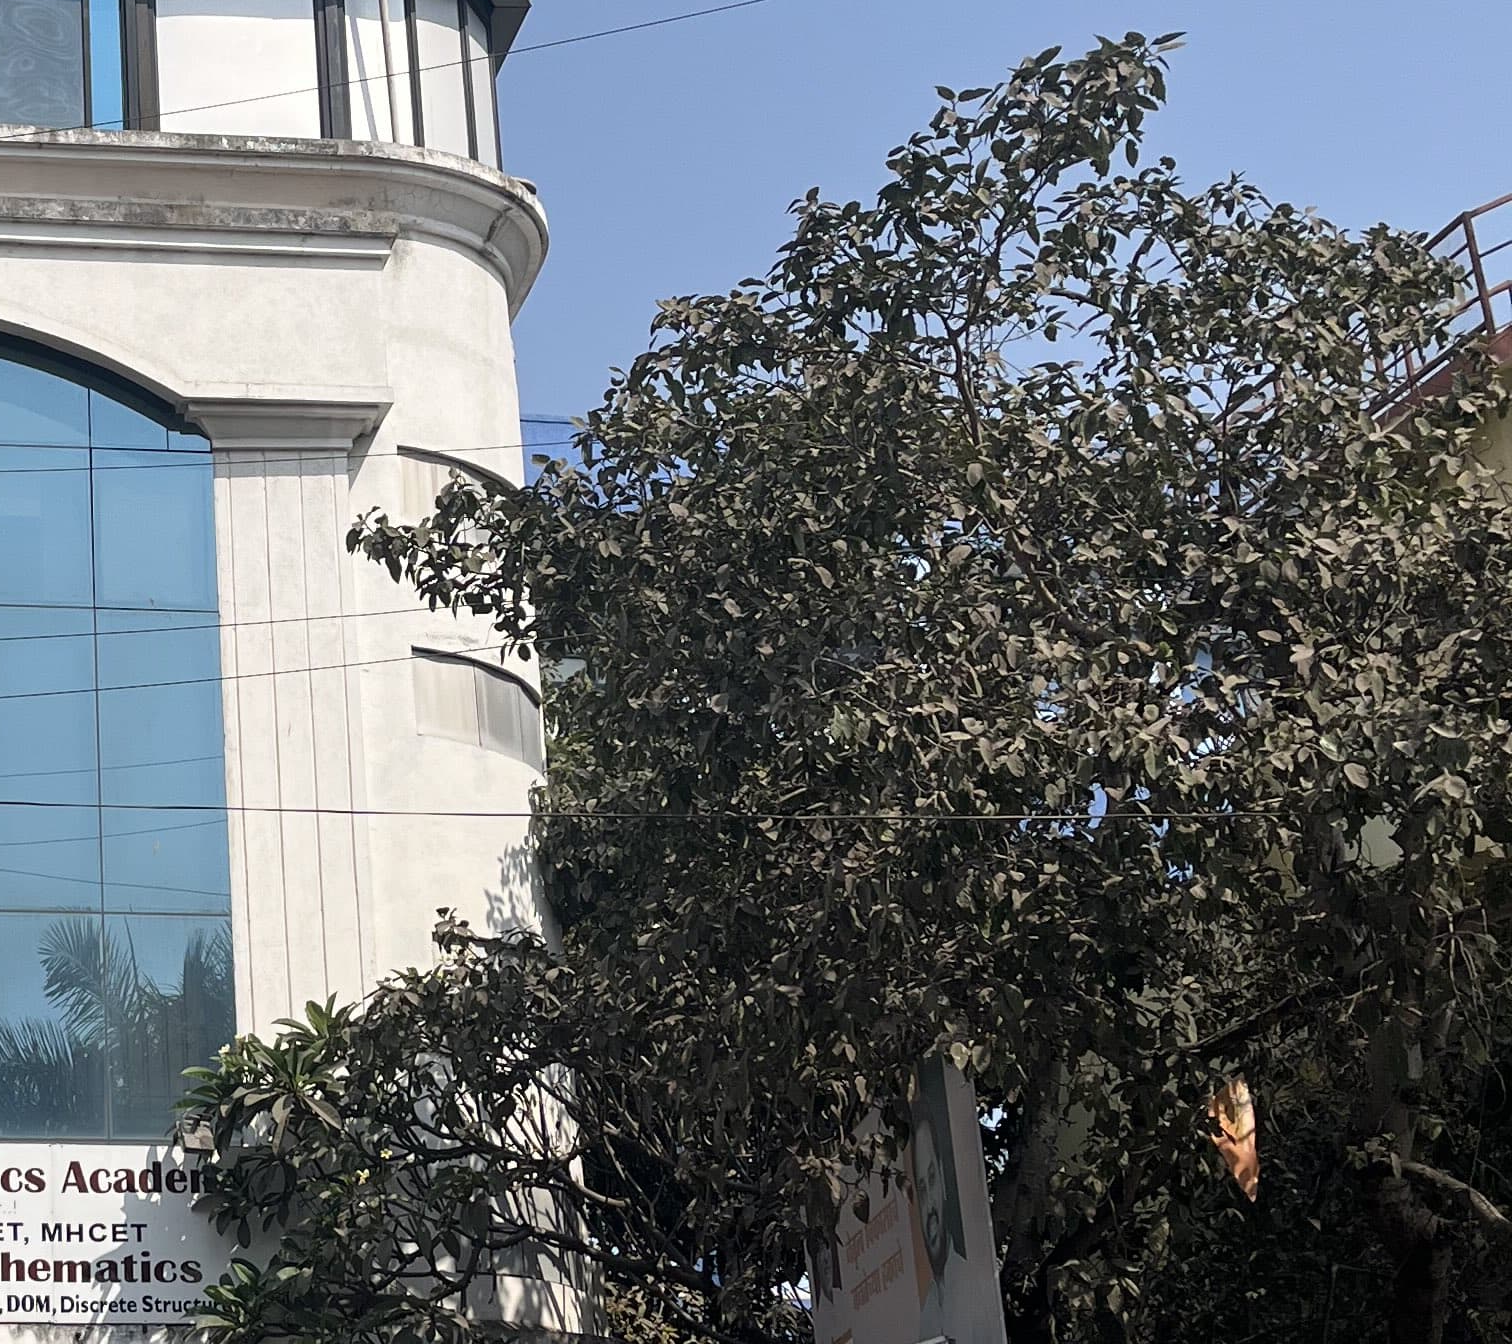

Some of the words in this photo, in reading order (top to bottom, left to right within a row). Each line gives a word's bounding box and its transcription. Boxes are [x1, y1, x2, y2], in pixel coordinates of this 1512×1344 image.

[62, 1159, 206, 1195] Acade
[41, 1223, 148, 1243] MHCET
[61, 1295, 137, 1313] Discrete
